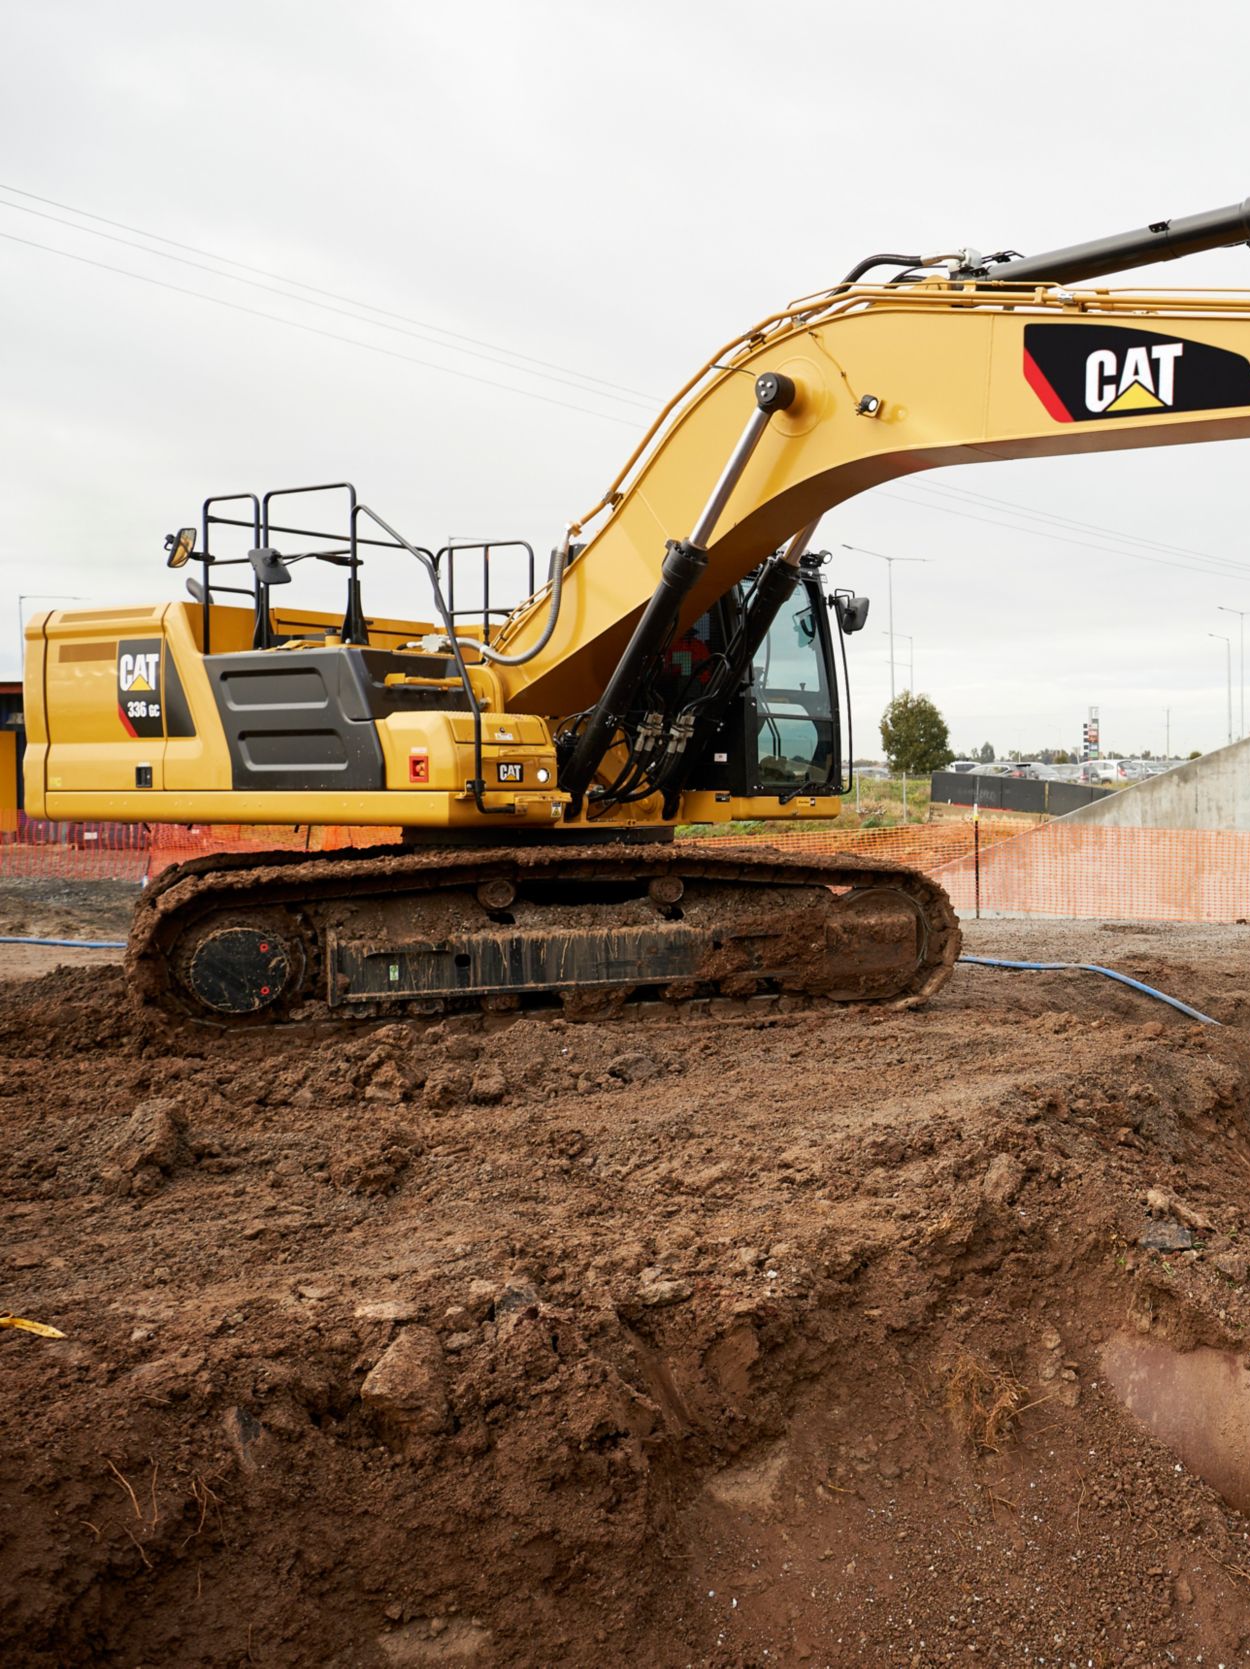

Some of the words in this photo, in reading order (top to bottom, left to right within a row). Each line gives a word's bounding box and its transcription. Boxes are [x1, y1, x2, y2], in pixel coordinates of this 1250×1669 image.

[1085, 342, 1183, 413] CAT
[120, 653, 159, 692] CAT
[127, 701, 147, 718] 336
[499, 764, 521, 781] CAT
